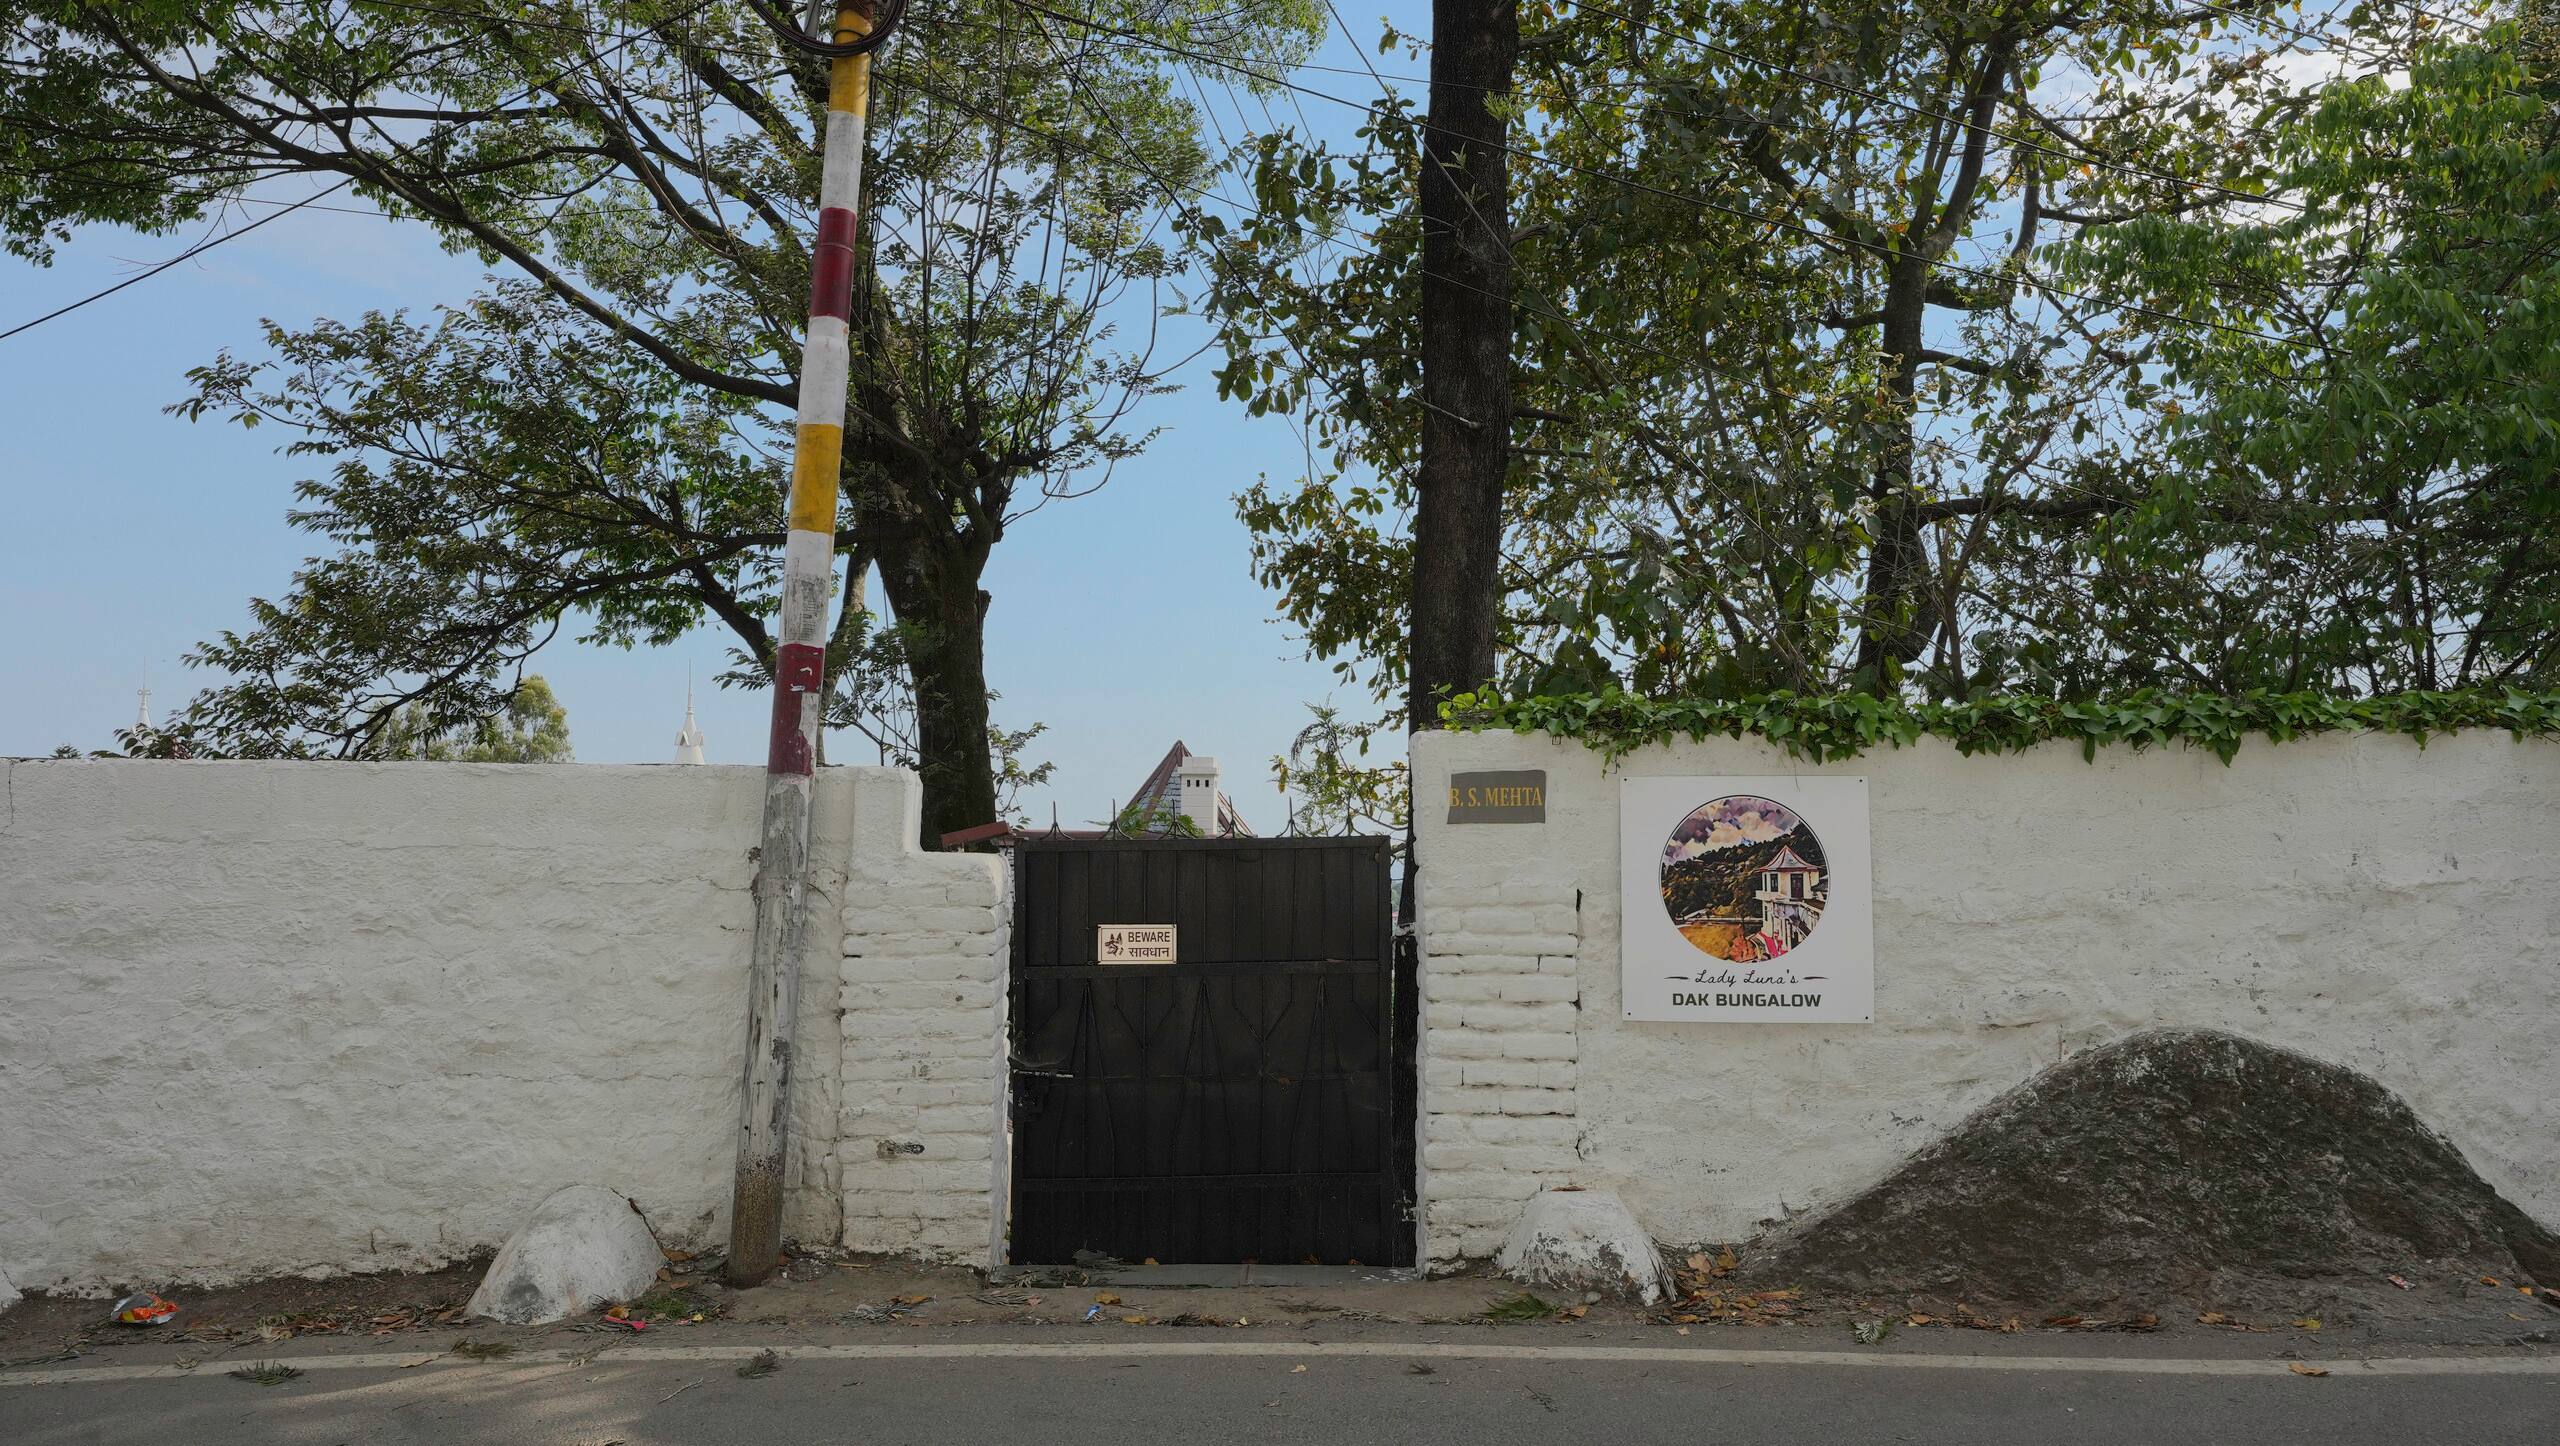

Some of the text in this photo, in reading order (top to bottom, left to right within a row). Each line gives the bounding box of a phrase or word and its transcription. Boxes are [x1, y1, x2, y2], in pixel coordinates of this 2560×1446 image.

[1447, 786, 1543, 807] B. S. MEHTA
[1128, 931, 1171, 943] BEWARE
[1128, 947, 1170, 957] सावधान
[1695, 969, 1799, 987] Lady Luna's
[1672, 993, 1822, 1007] DAK BUNGALOW
